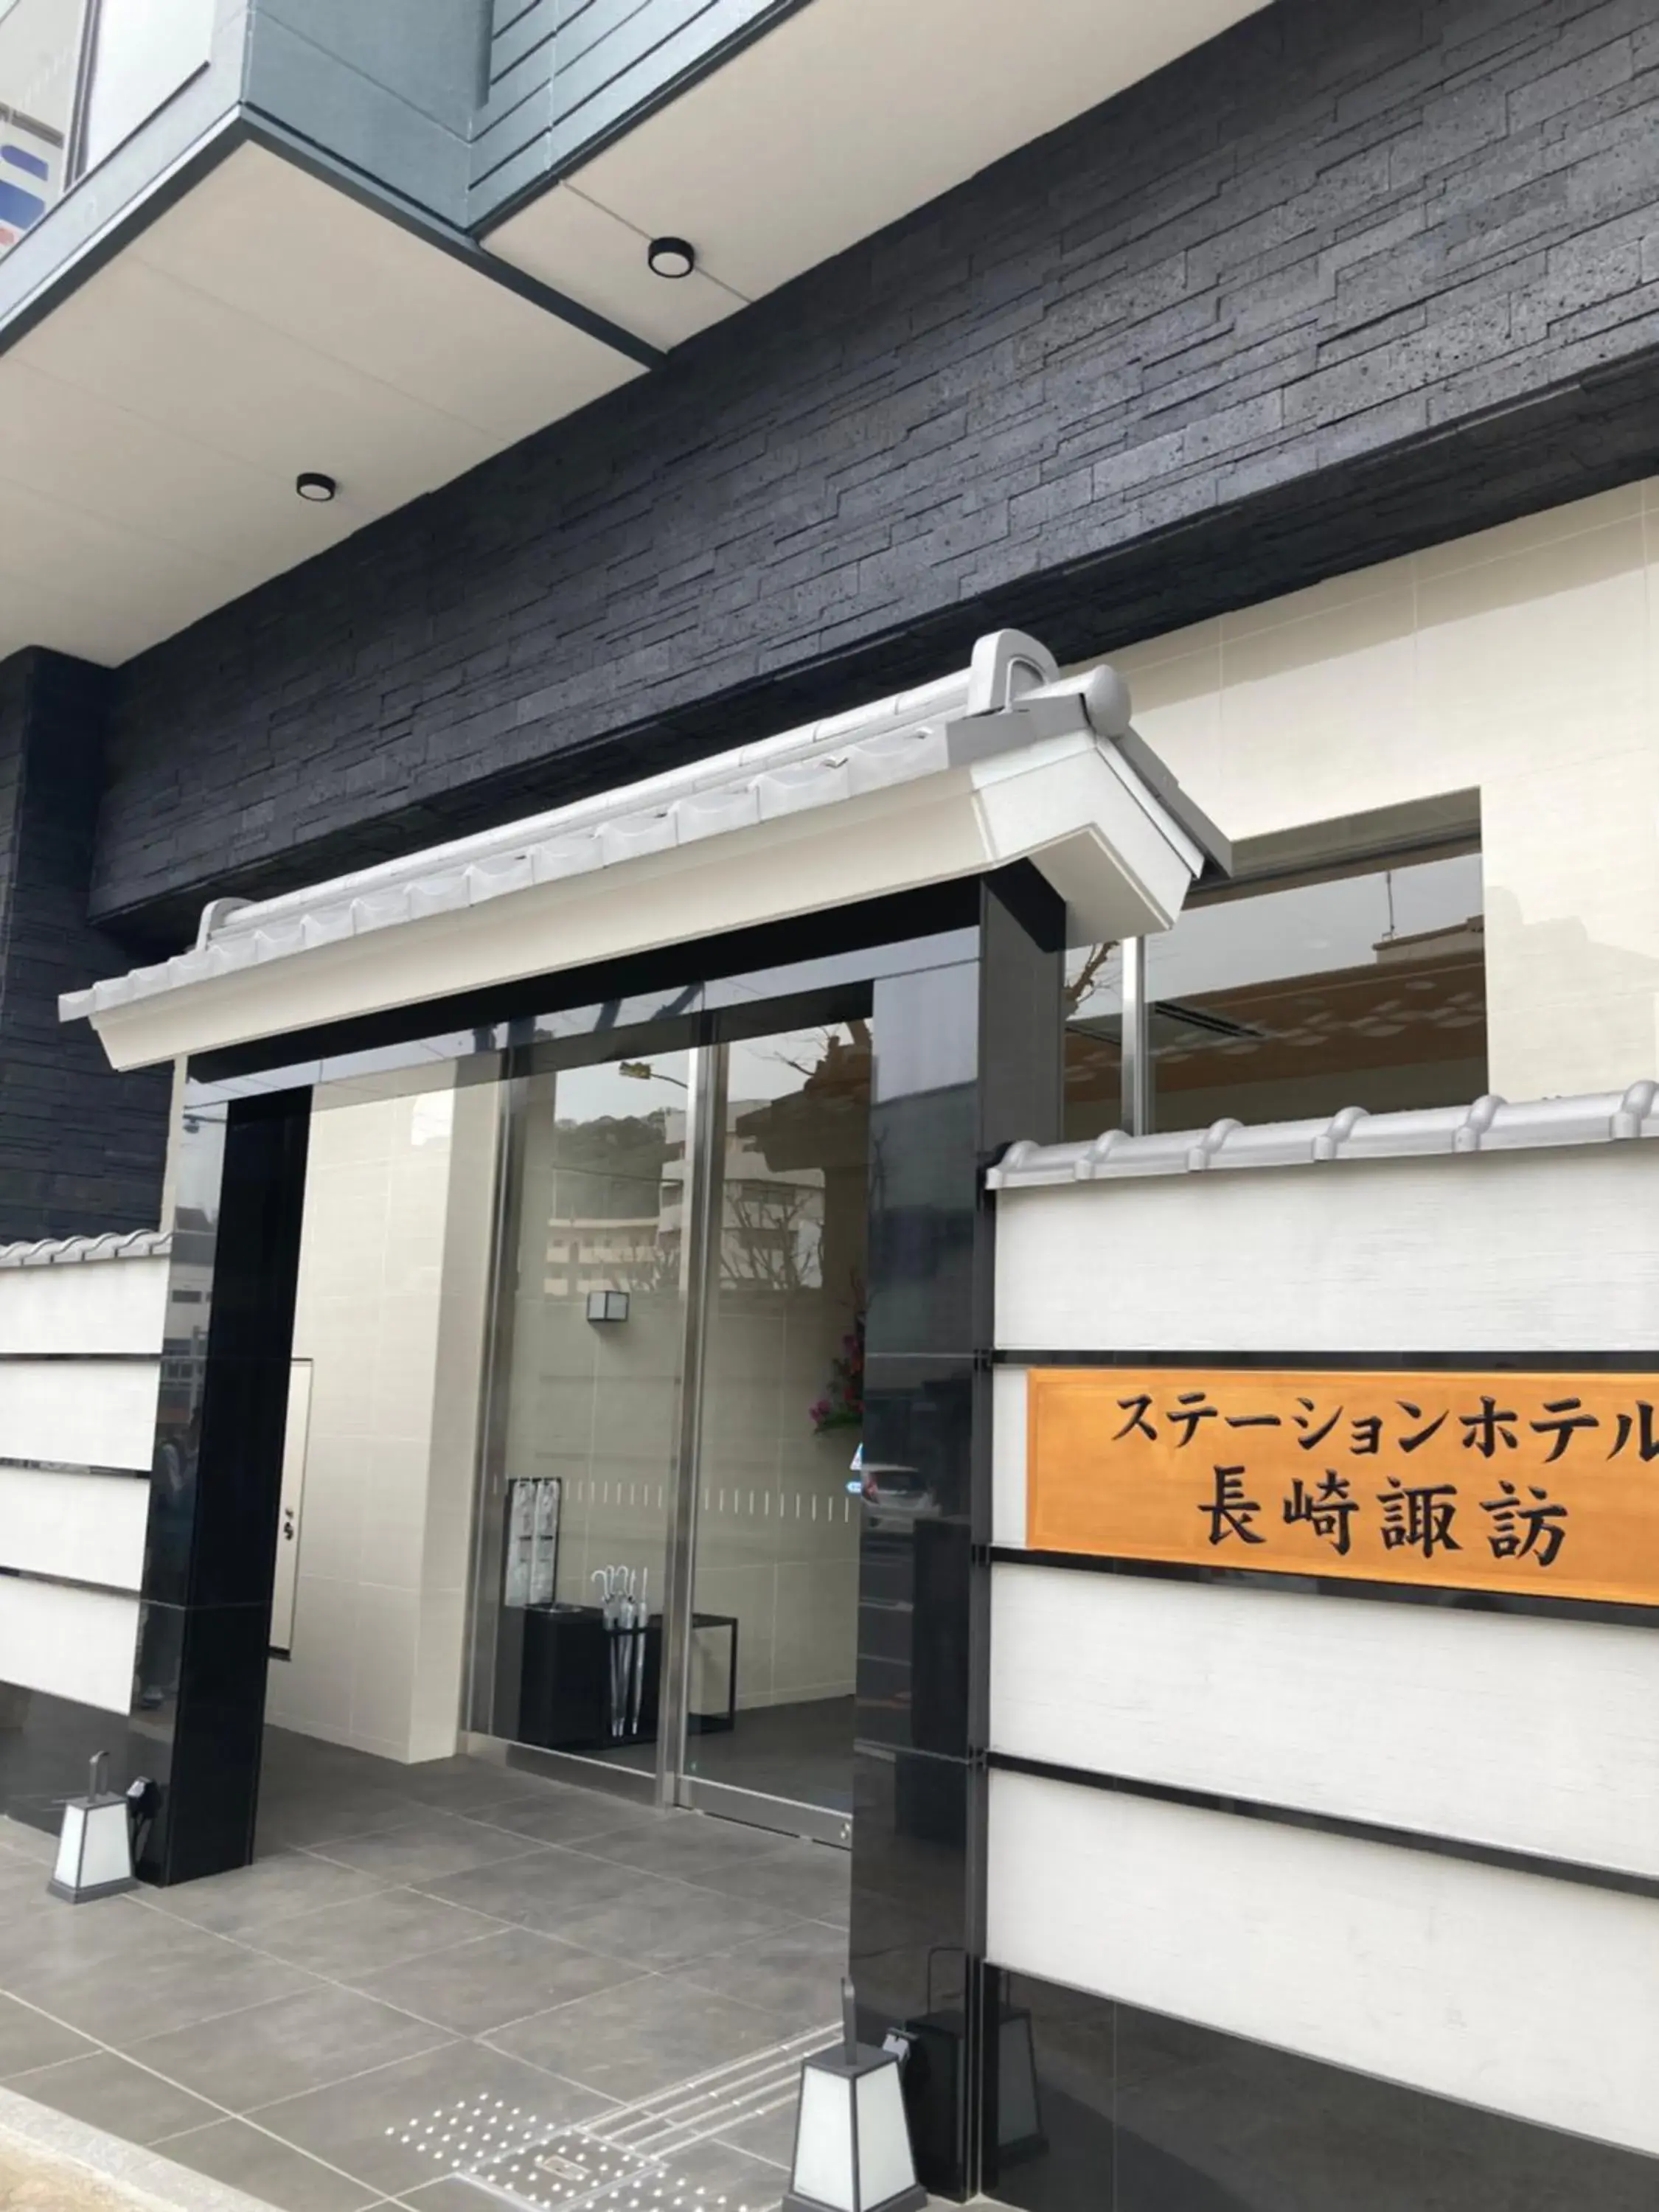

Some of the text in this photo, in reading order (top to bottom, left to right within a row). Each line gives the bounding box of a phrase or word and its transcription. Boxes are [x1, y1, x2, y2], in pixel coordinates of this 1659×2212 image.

[1111, 1391, 1659, 1463] ステーションホテル
[1197, 1465, 1569, 1567] 長崎諏訪
